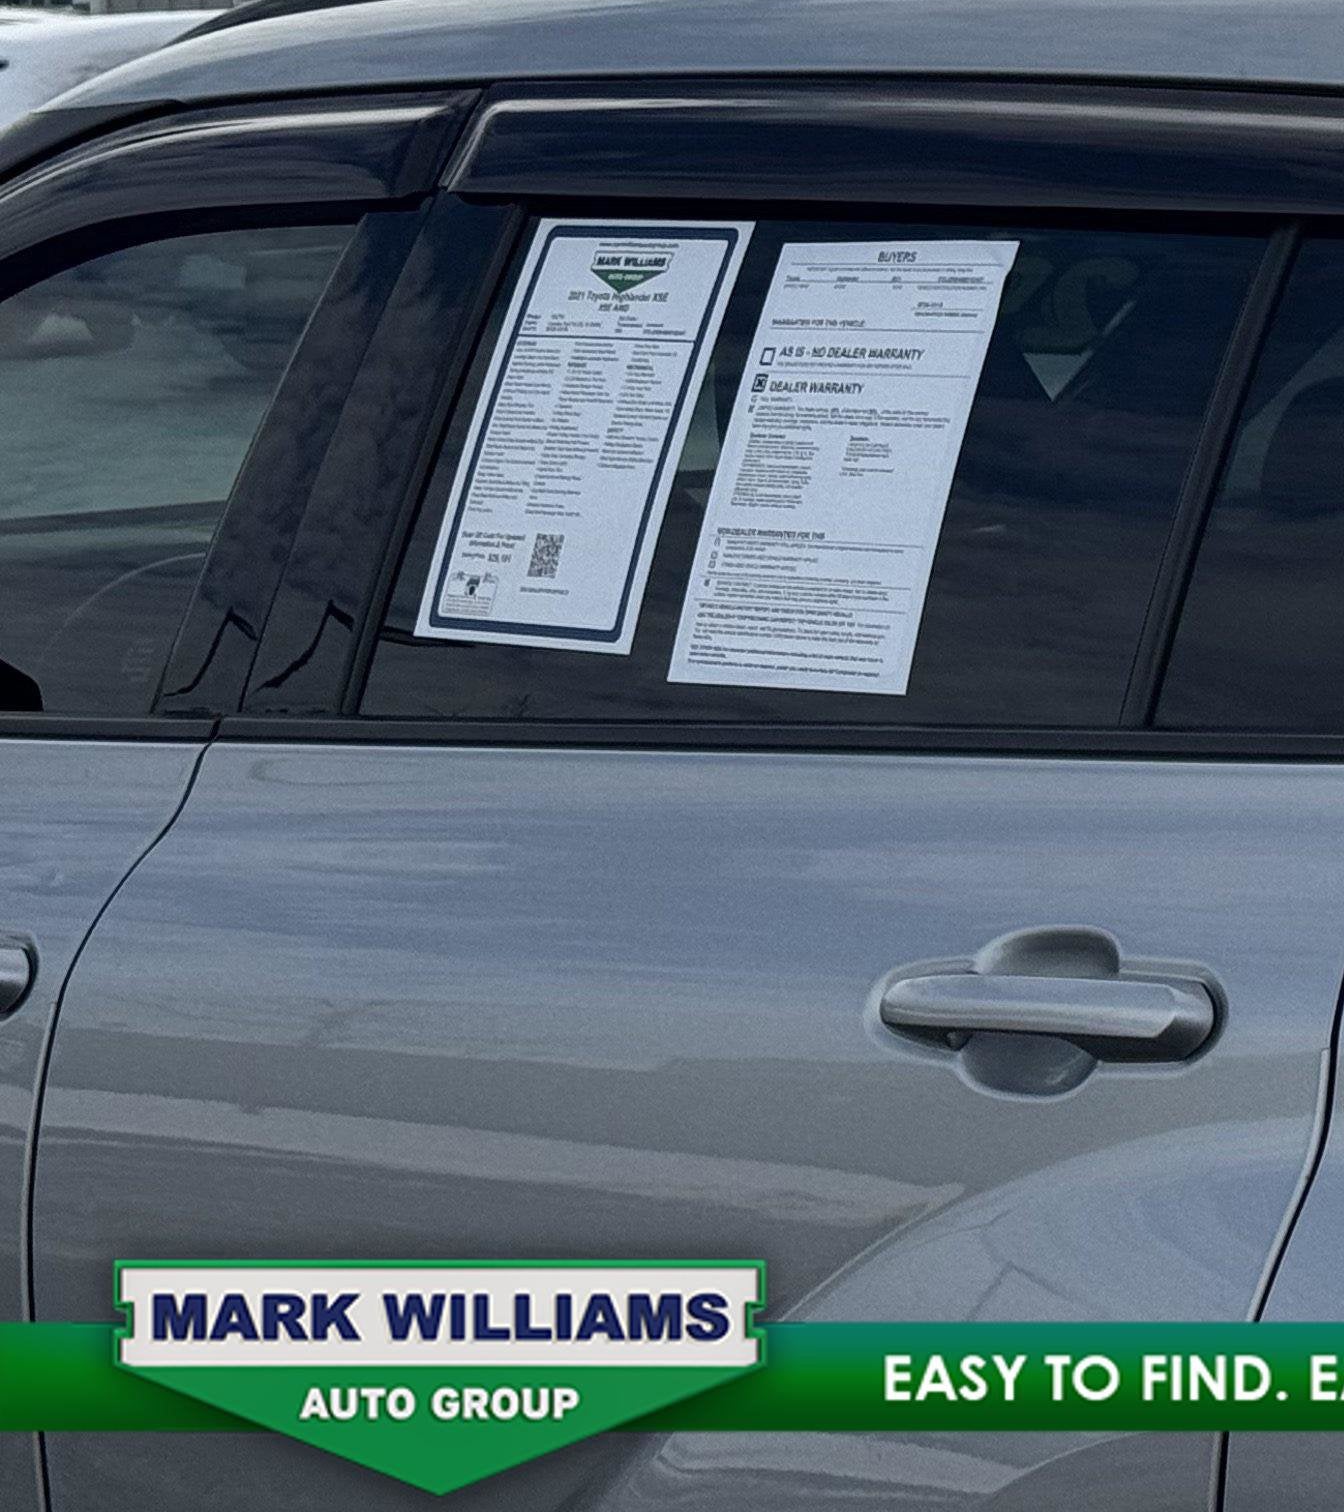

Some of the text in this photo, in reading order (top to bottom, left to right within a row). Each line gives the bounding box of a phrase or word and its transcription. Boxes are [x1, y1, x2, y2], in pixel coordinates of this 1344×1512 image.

[596, 256, 667, 267] MARK WILLIAMS
[877, 251, 918, 263] BUYERS
[778, 346, 794, 357] AS
[795, 347, 806, 358] IS
[811, 347, 827, 358] NO
[826, 347, 867, 359] DEALER
[867, 348, 925, 361] WARRANTY
[769, 381, 865, 395] DEALER WARRANTY
